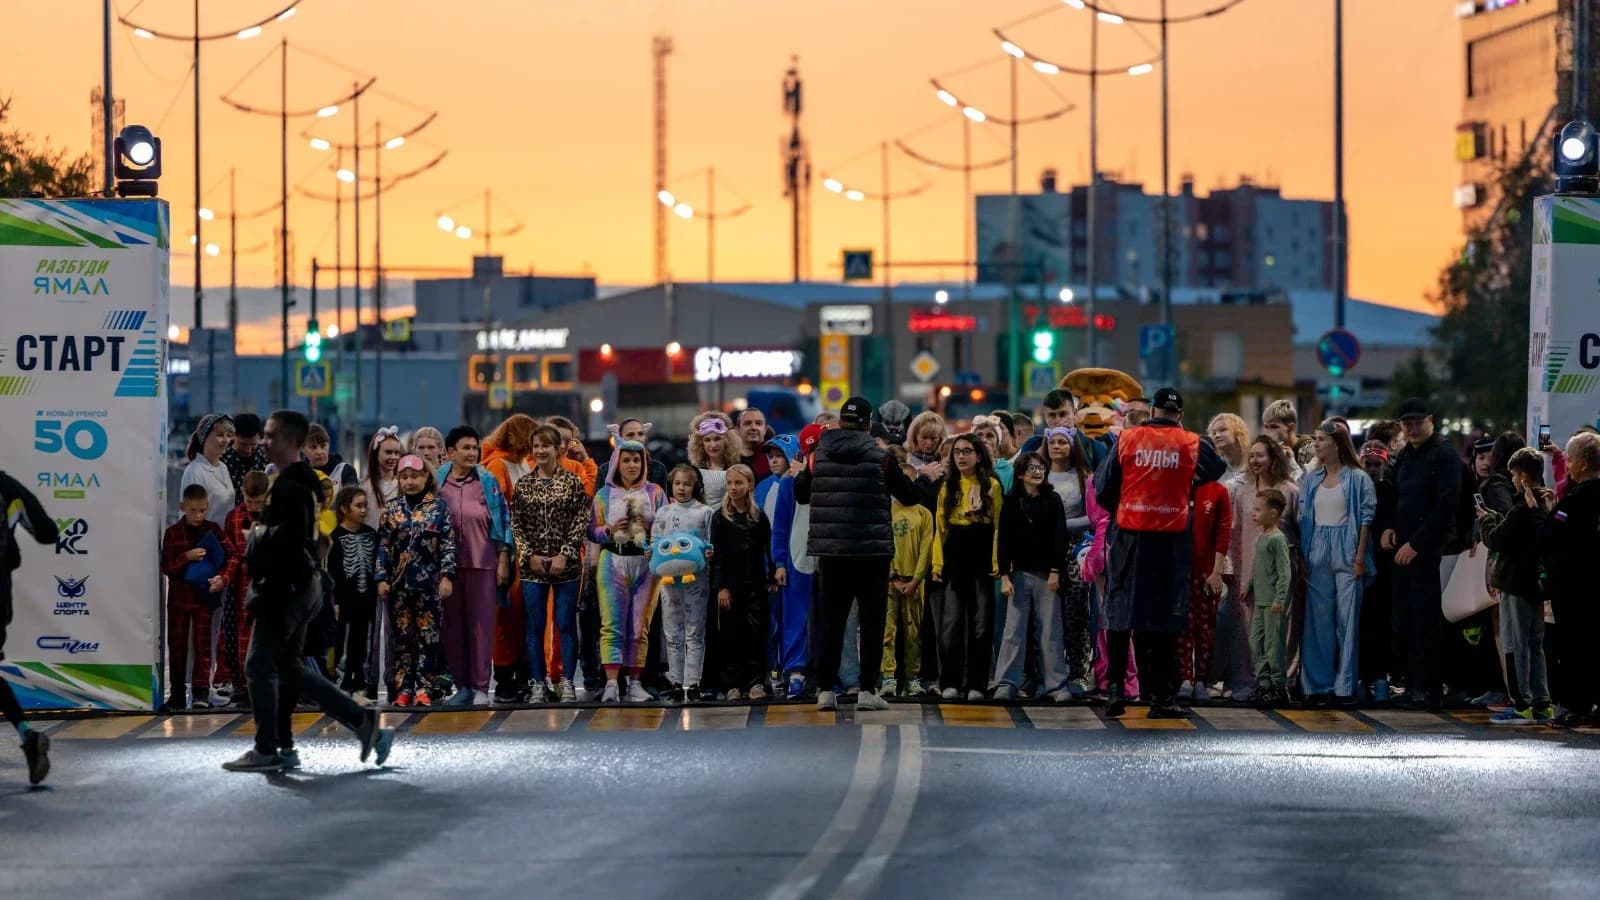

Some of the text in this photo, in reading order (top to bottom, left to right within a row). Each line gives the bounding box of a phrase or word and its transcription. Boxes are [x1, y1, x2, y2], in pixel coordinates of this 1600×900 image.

[36, 259, 110, 276] РАЗБУДИ
[33, 277, 110, 295] ЯМАЛ
[16, 334, 126, 371] СТАРТ
[34, 419, 109, 461] 50
[1135, 449, 1180, 470] СУДЬЯ
[37, 472, 101, 488] ЯМАЛ
